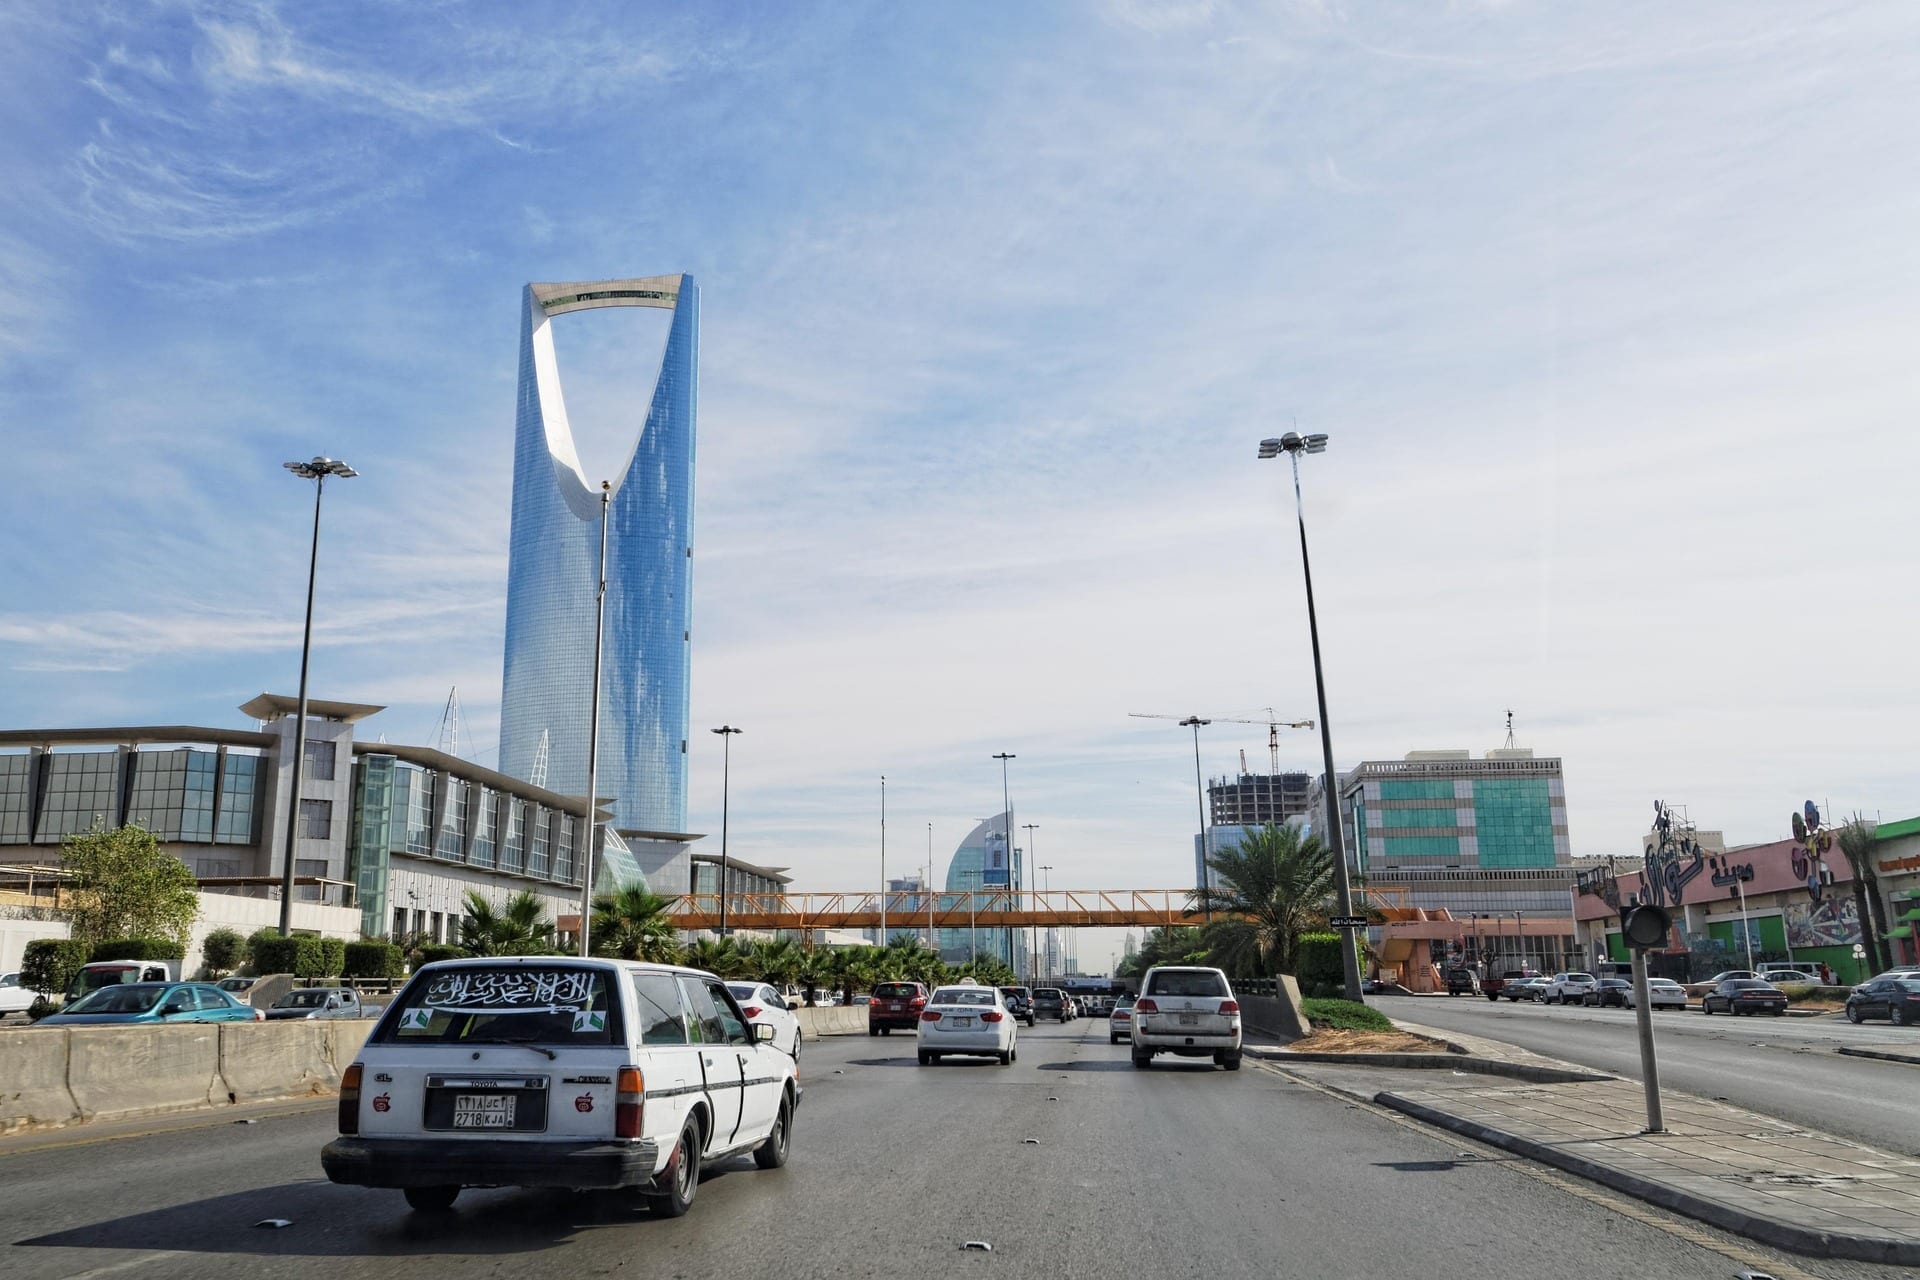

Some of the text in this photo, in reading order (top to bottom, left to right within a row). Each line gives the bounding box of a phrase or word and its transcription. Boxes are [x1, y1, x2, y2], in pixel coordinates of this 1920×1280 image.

[374, 1073, 393, 1082] GL
[456, 1112, 504, 1126] 2718 KJA
